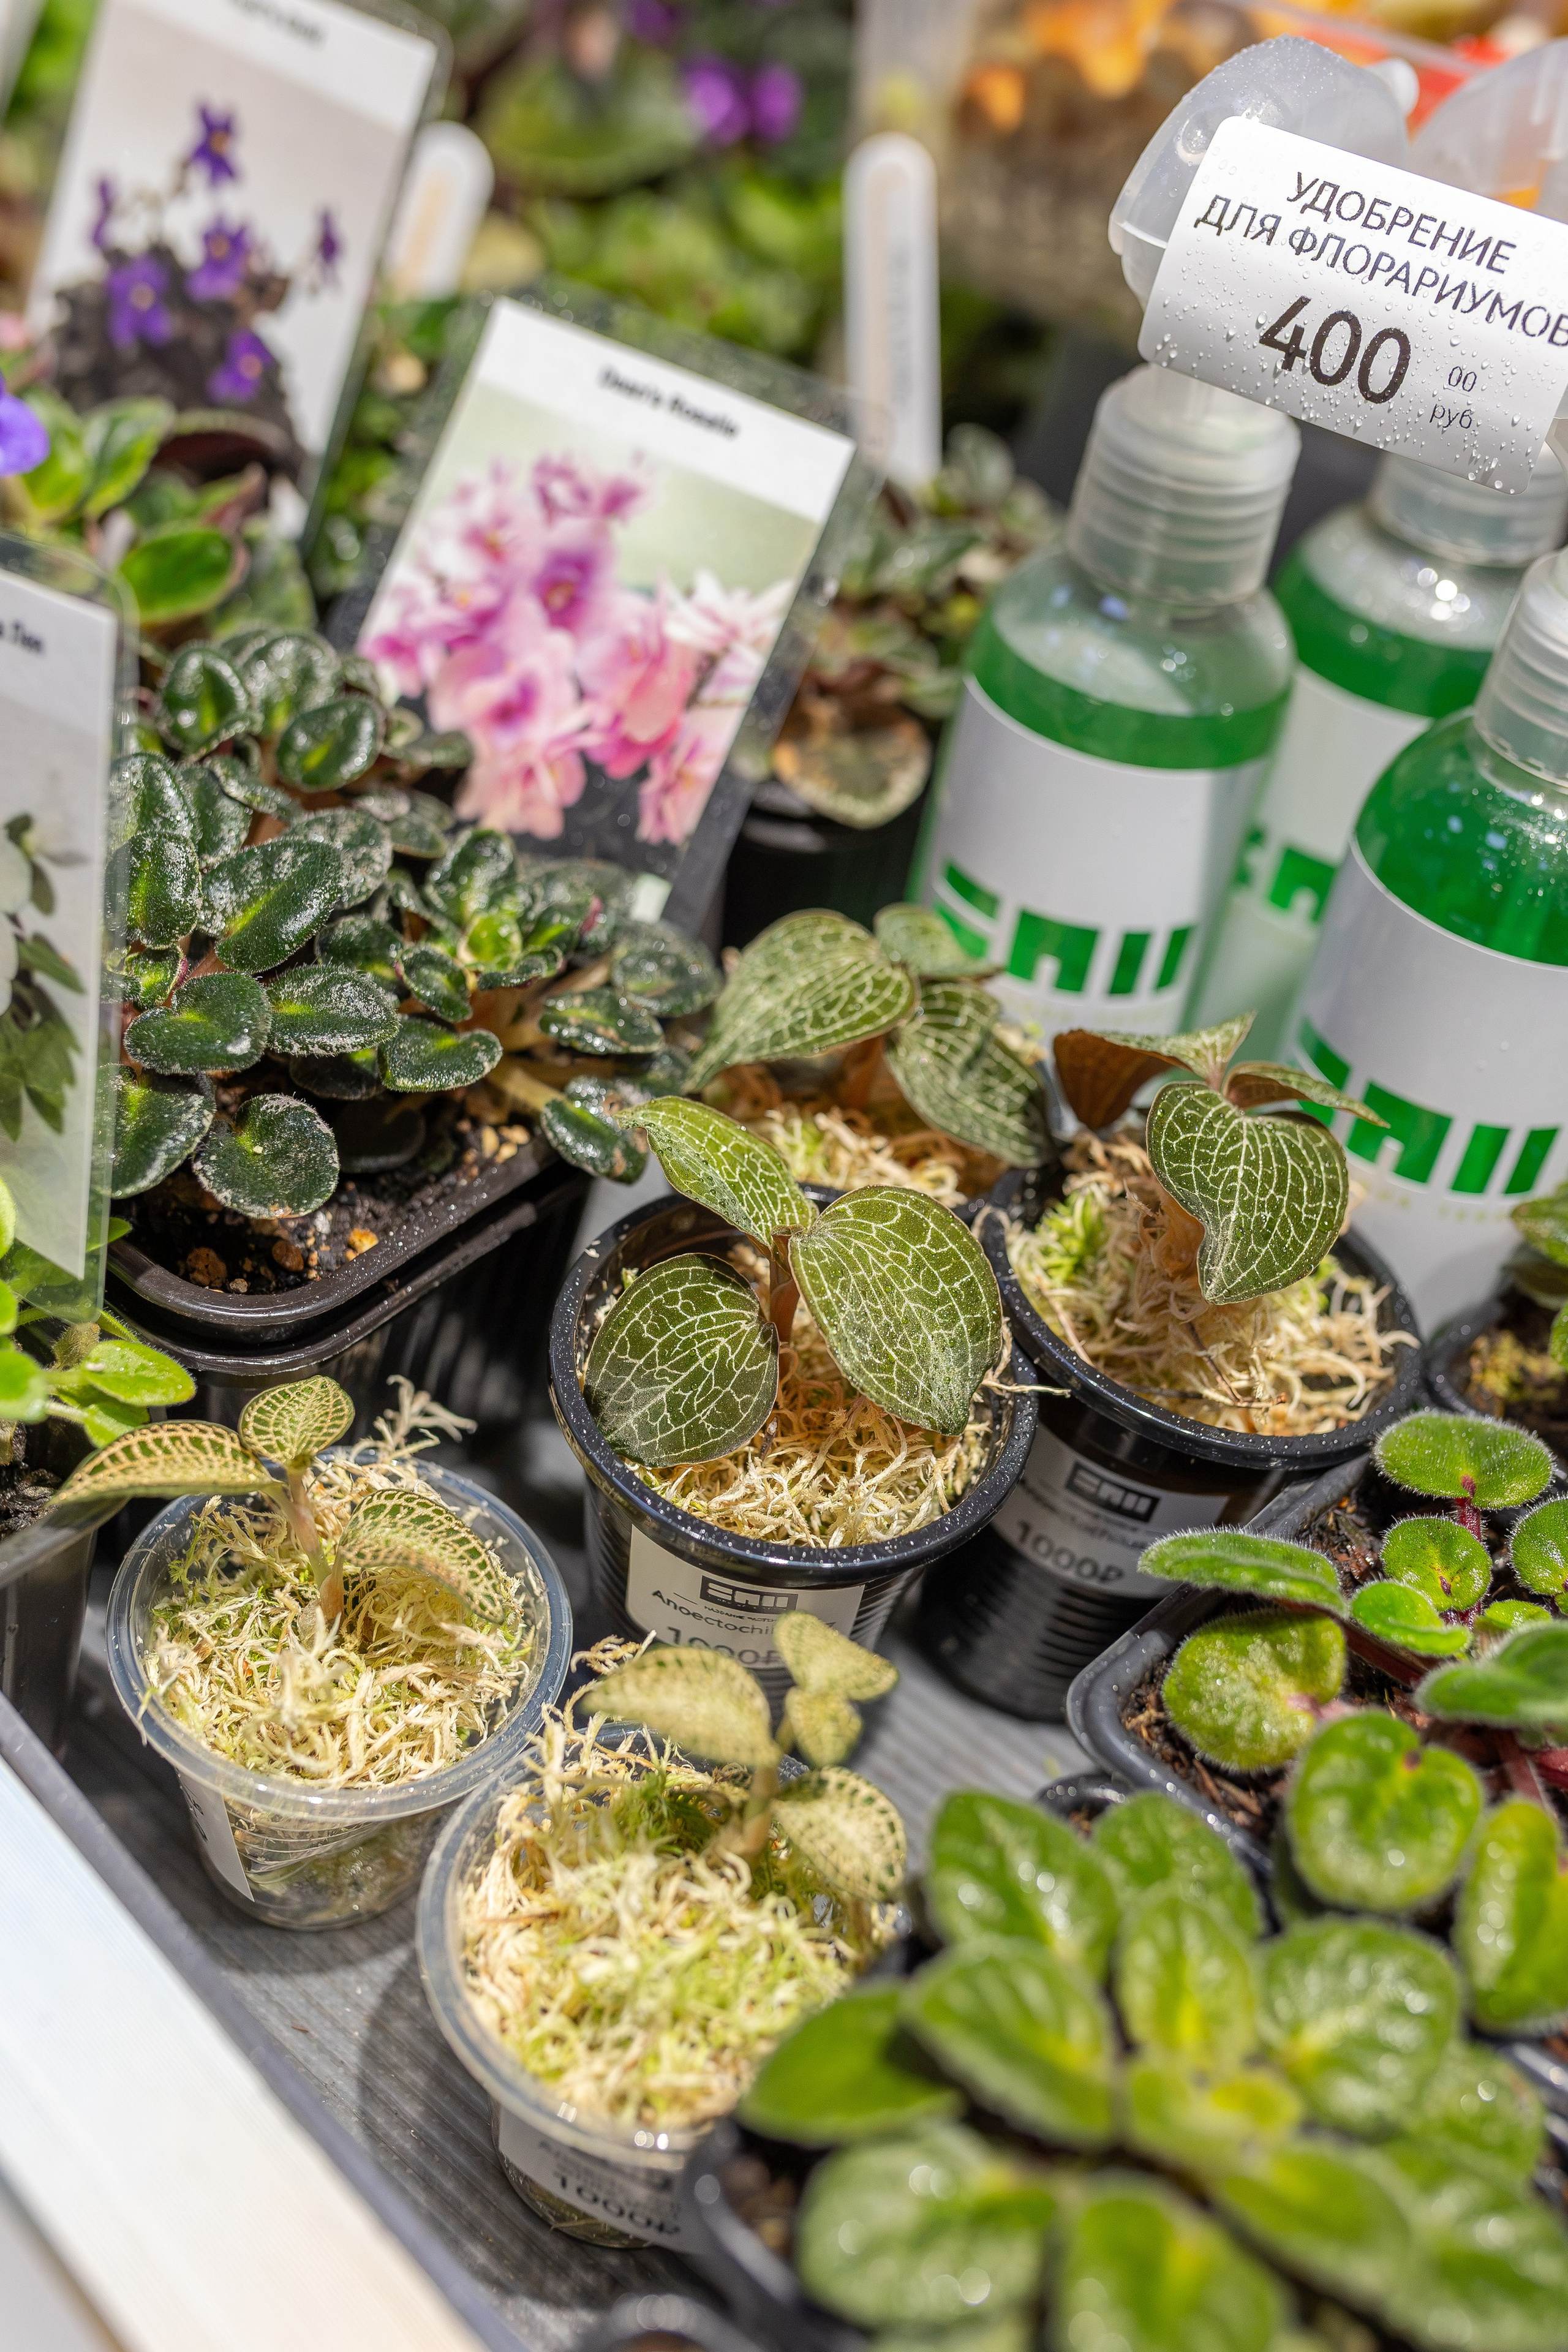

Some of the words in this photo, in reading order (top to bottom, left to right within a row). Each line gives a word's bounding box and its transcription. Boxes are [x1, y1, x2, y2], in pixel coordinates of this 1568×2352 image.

[1194, 194, 1282, 246] ДЛЯ
[1288, 226, 1568, 347] ФЛОРАРИУМОВ
[1287, 172, 1517, 274] УДОБРЕНИЕ
[1259, 295, 1411, 405] 400
[1448, 366, 1477, 392] 00
